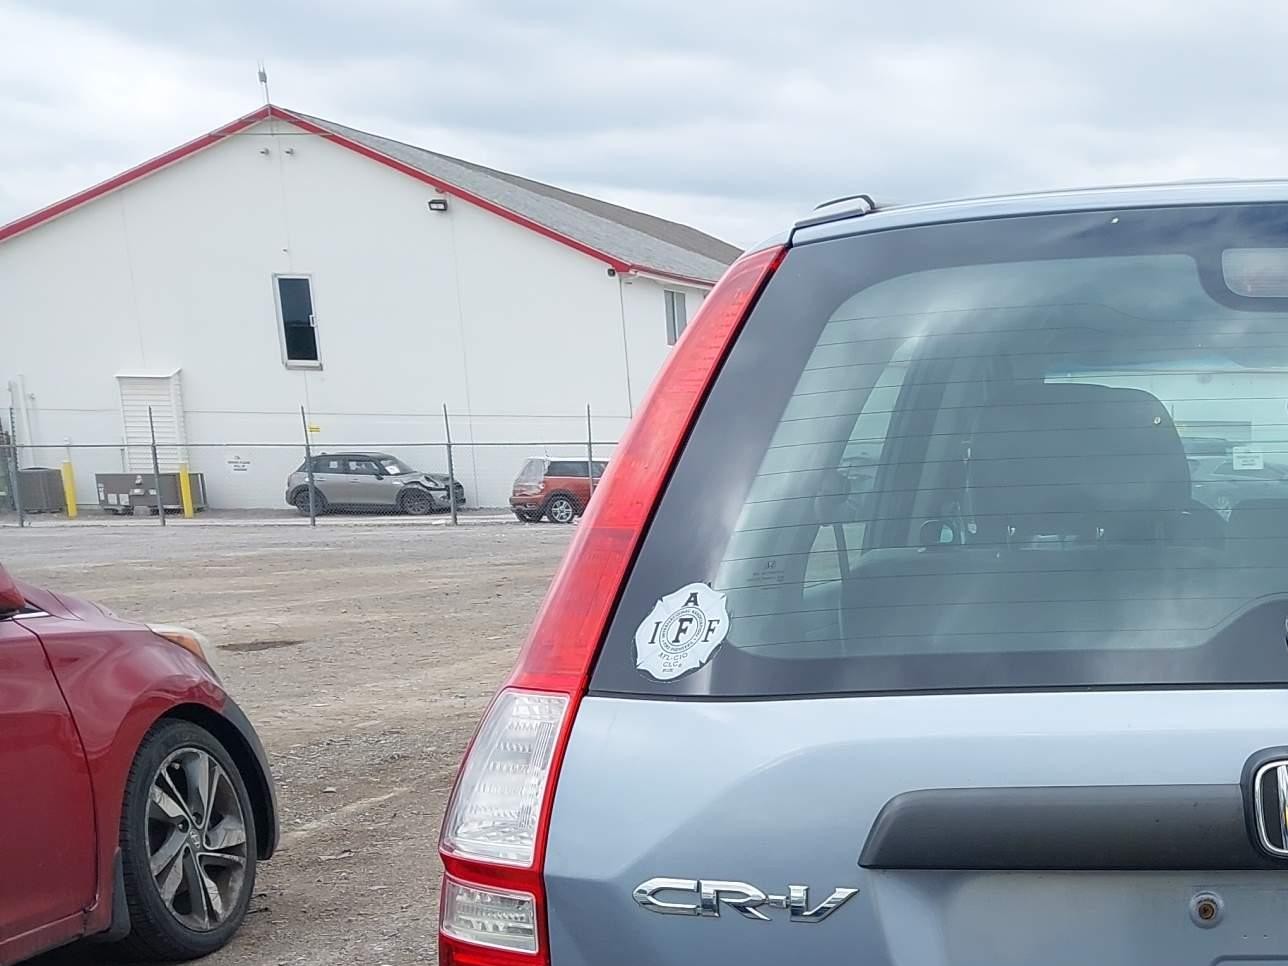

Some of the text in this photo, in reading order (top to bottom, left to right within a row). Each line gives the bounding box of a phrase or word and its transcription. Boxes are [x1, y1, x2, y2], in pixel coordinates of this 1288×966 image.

[682, 592, 699, 607] A
[672, 618, 693, 643] F
[702, 620, 720, 642] F
[632, 877, 859, 923] CR-V
